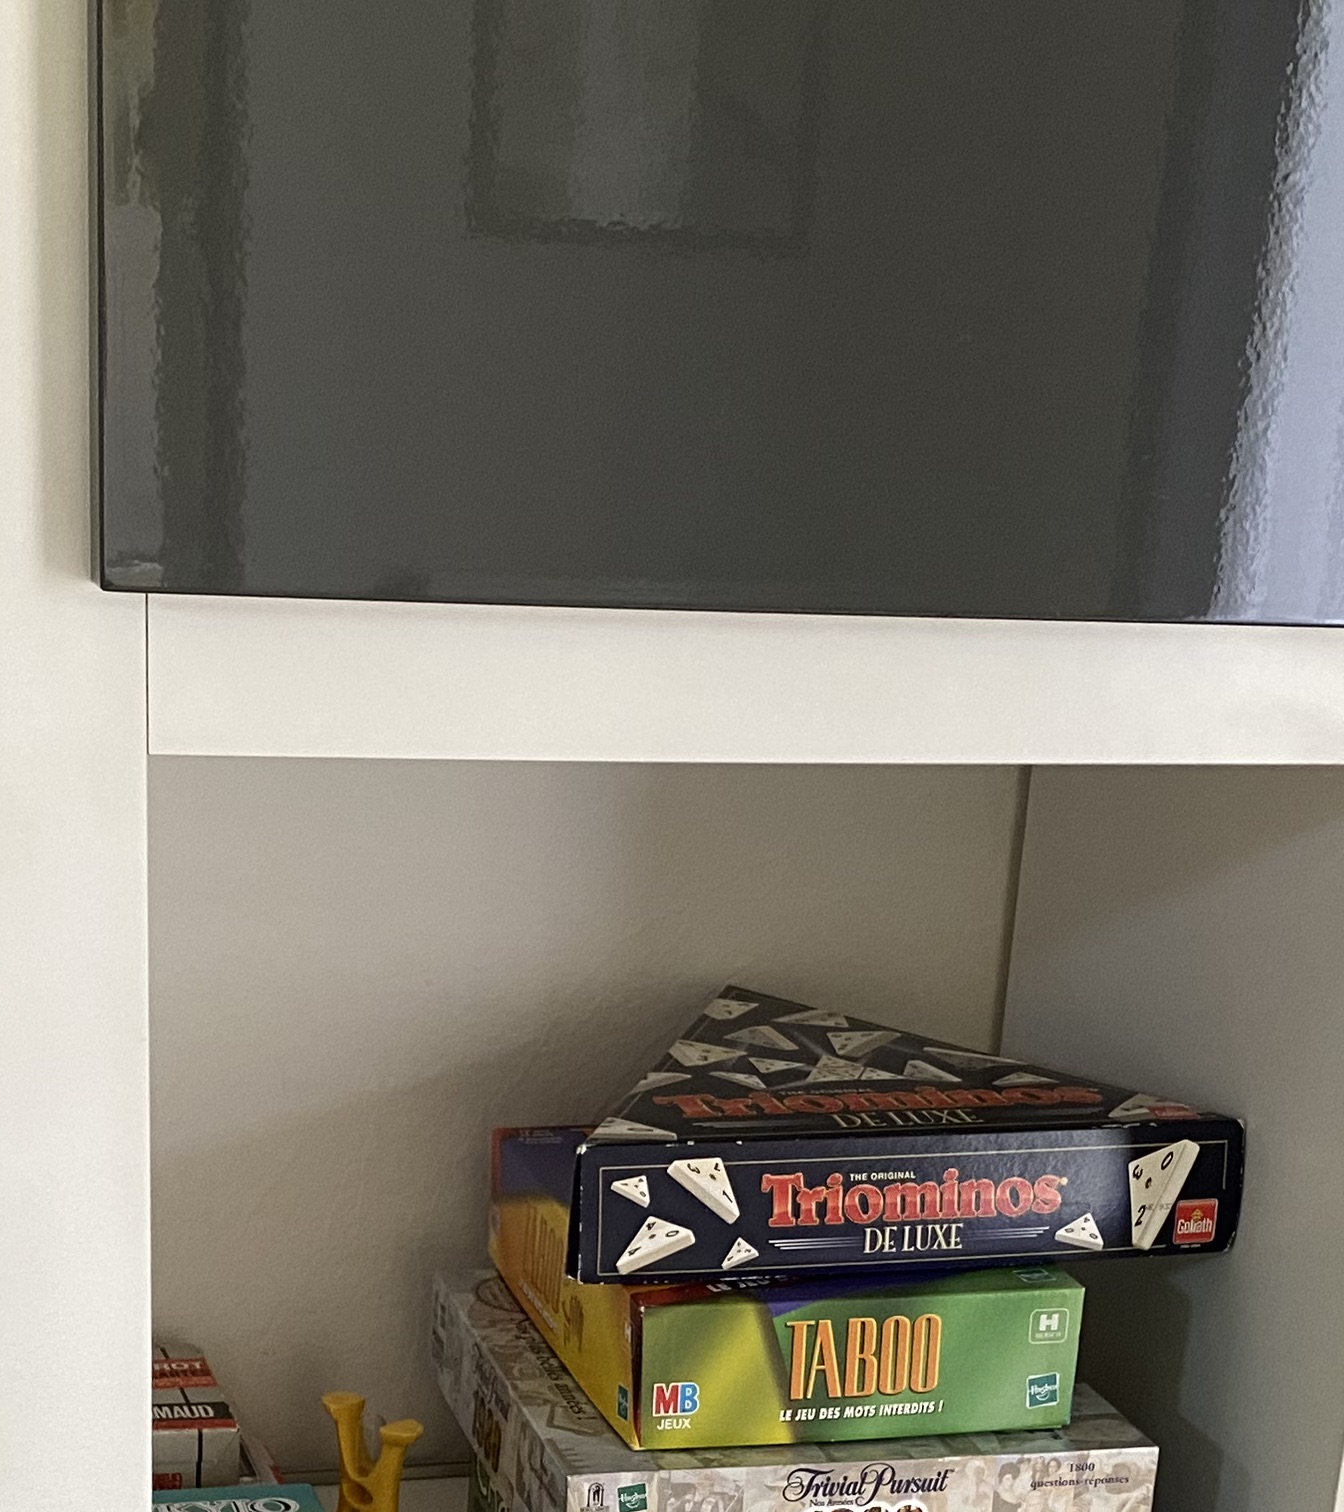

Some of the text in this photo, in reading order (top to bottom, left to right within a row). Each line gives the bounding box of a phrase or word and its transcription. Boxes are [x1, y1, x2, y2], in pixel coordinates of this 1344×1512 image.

[849, 1170, 917, 1182] THE ORIGINAL
[760, 1167, 1063, 1228] Triominos
[1177, 1218, 1213, 1235] Goliath
[785, 1313, 942, 1400] TABOO
[652, 1382, 700, 1418] MB
[152, 1404, 215, 1420] MAUD
[779, 1409, 794, 1422] LE
[795, 1408, 817, 1422] JEU
[819, 1407, 841, 1421] DES
[843, 1404, 876, 1419] MOTS
[879, 1401, 934, 1417] INTERDITS
[657, 1418, 692, 1430] JEUX
[1069, 1462, 1096, 1473] 1800
[782, 1462, 950, 1507] Trivial Pursuit
